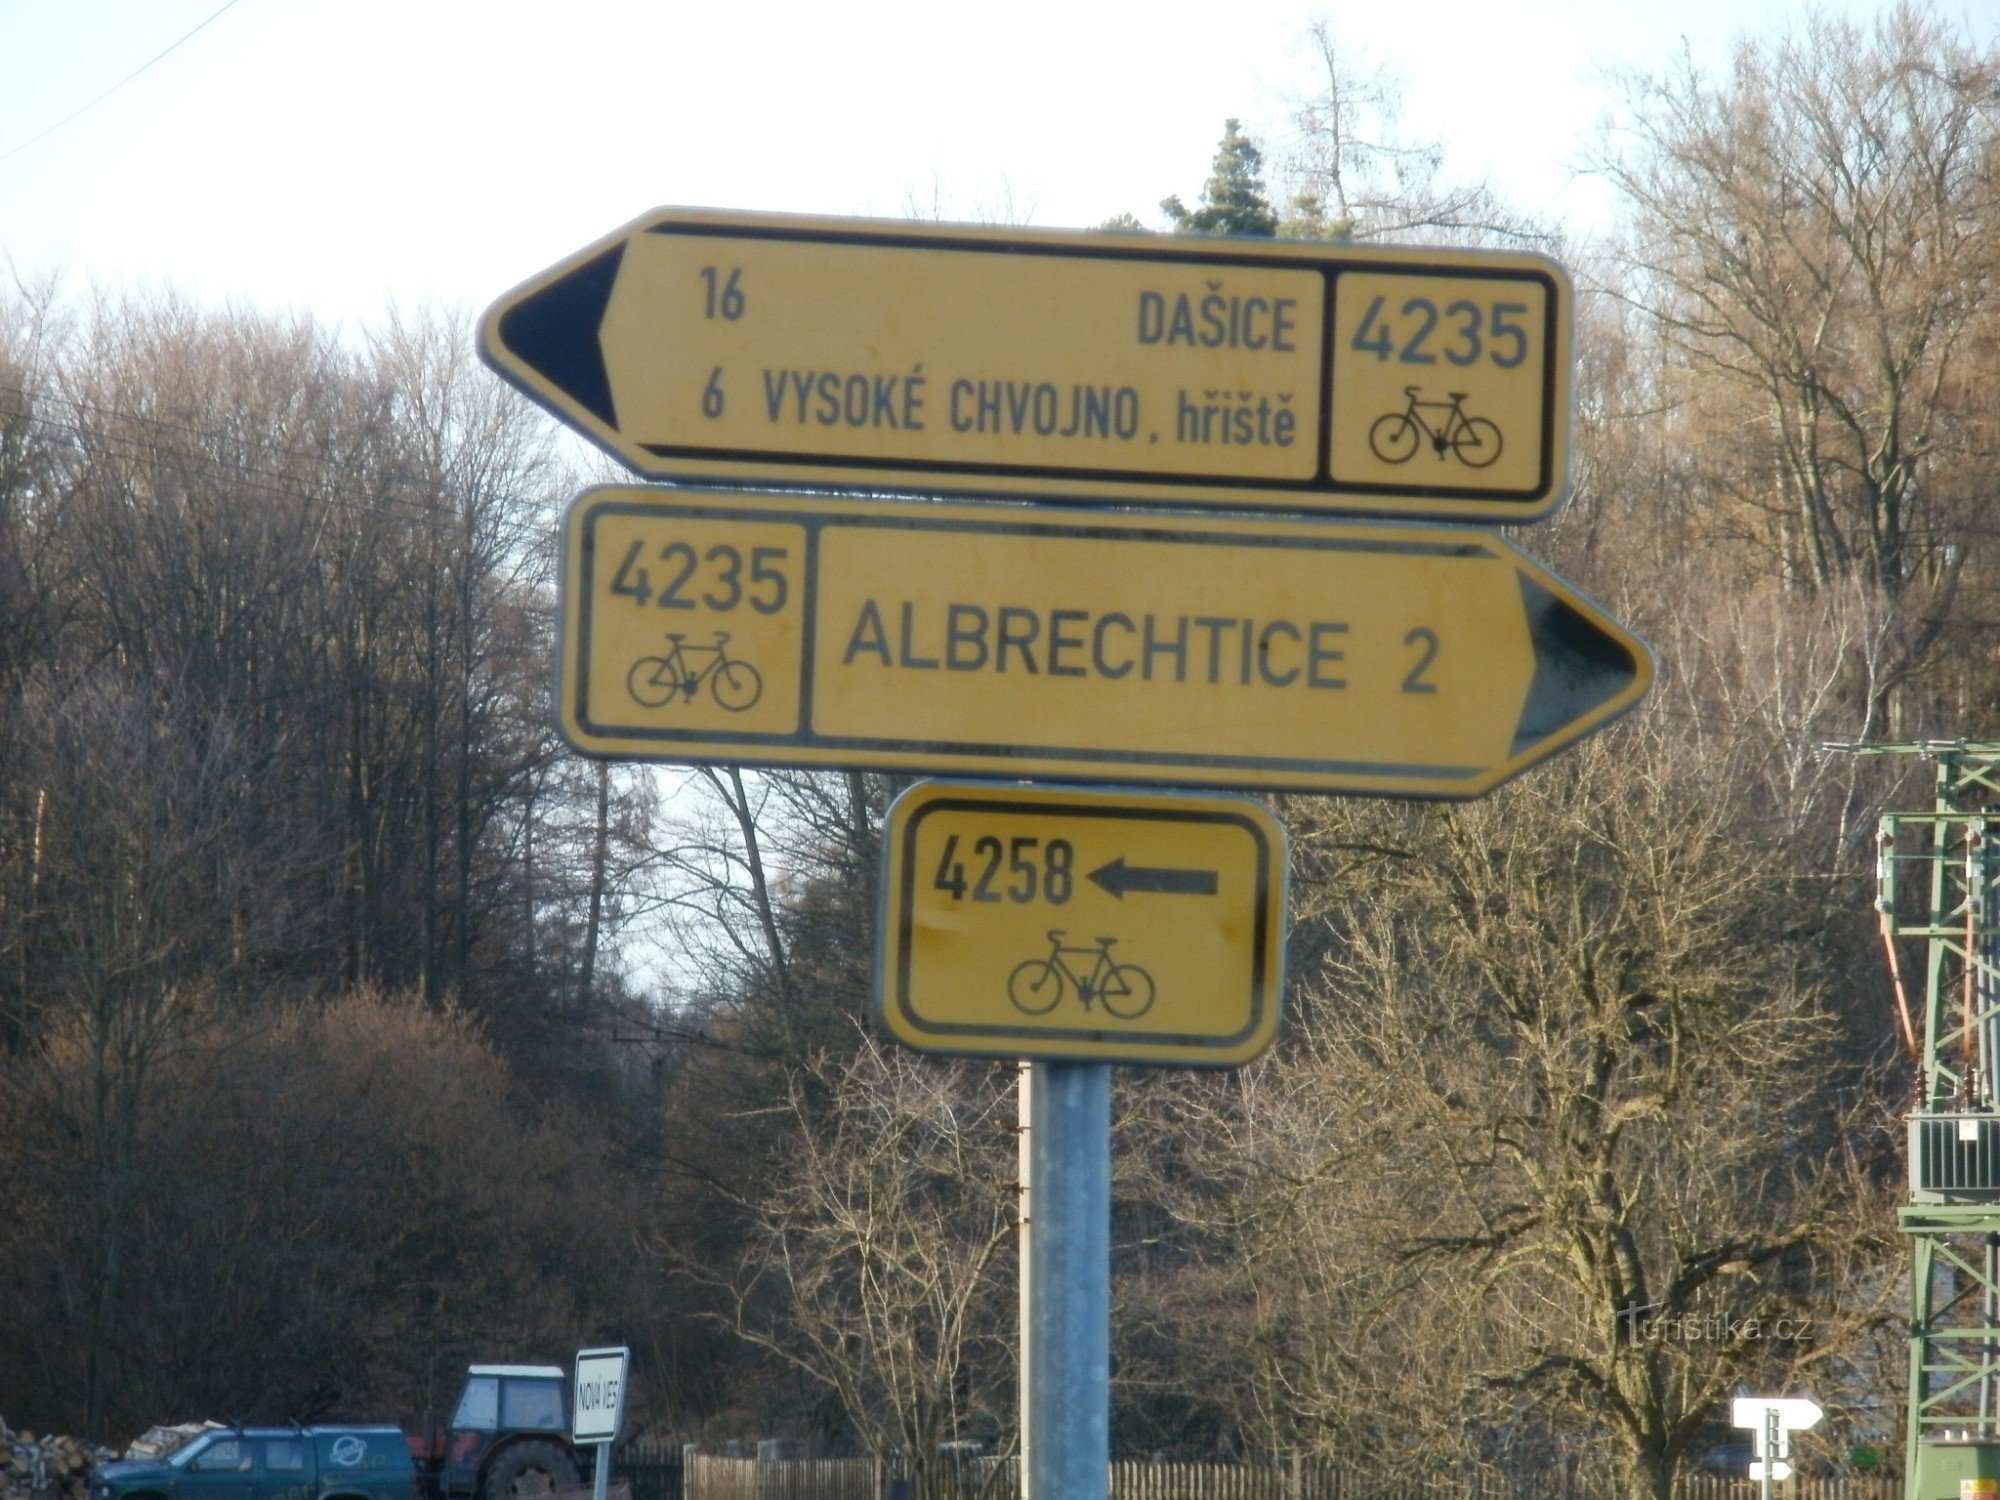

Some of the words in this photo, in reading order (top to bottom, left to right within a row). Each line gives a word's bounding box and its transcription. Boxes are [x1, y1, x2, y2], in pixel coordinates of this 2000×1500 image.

[700, 267, 745, 320] 16
[1138, 282, 1296, 352] DAŠICE
[1352, 296, 1528, 368] 4235
[703, 367, 725, 419] 6
[763, 363, 925, 431] VYSOKÉ
[1176, 390, 1297, 447] hřiště
[609, 540, 788, 615] 4235
[842, 600, 1350, 690] ALBRECHTICE
[1401, 627, 1440, 694] 2
[935, 834, 1074, 905] 4258
